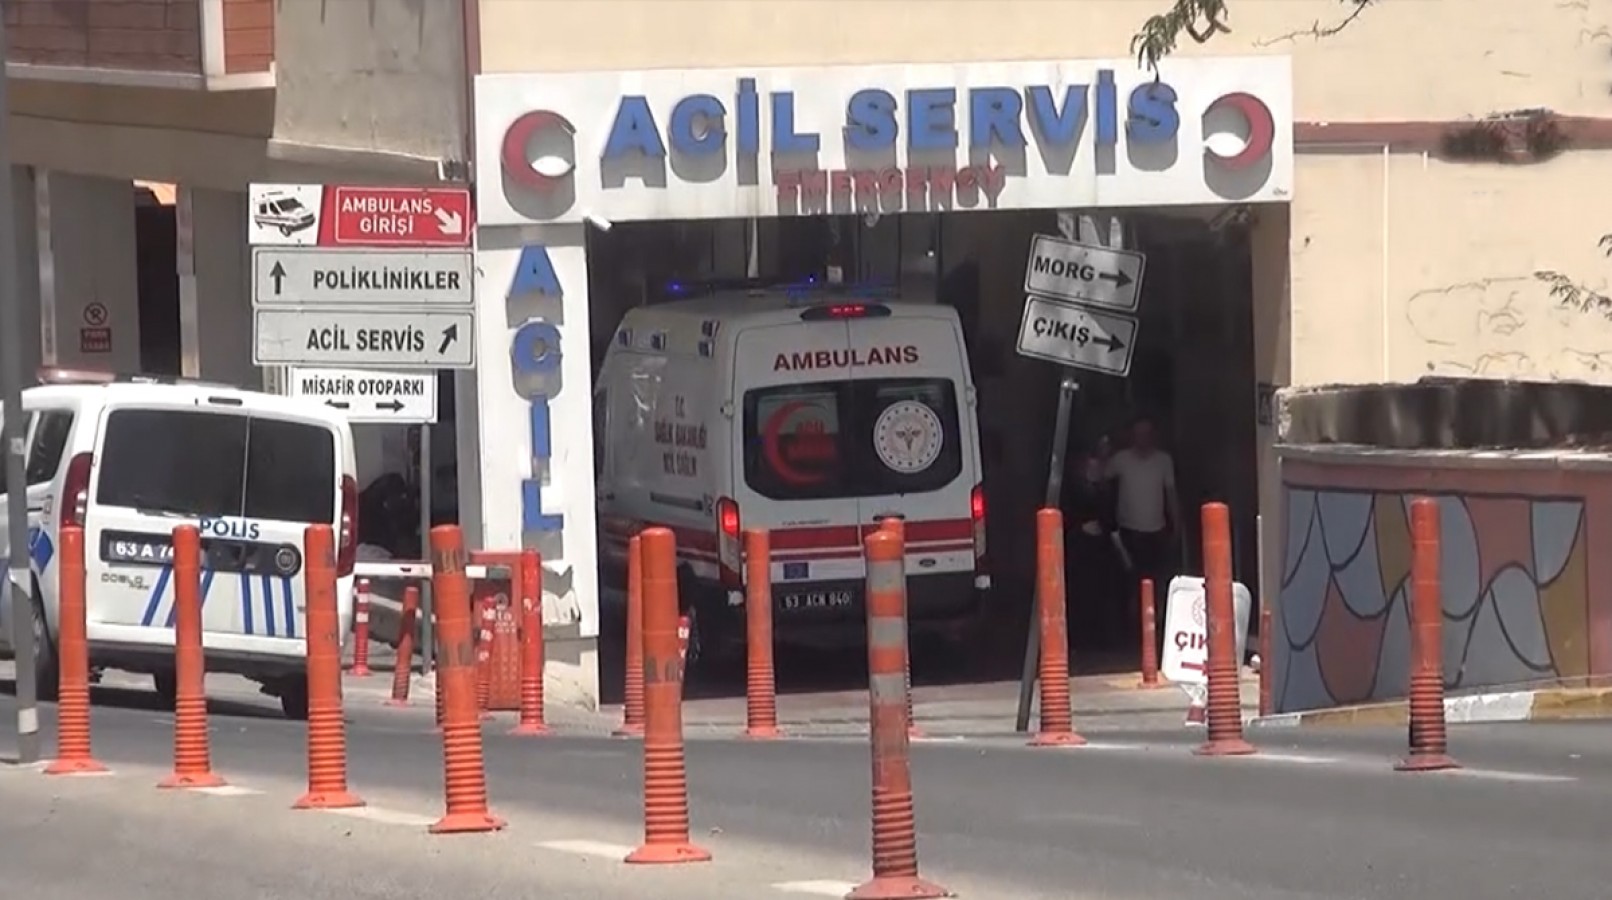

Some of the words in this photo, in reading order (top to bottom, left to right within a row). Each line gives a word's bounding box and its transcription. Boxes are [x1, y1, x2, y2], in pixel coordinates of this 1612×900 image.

[602, 78, 820, 158] ACİL
[846, 69, 1180, 152] SERVİS
[341, 197, 433, 213] AMBULANS
[359, 214, 414, 236] GİRİŞİ
[313, 266, 461, 291] POLİKLİNİKLER
[1033, 255, 1096, 282] MORG
[306, 324, 350, 351] ACİL
[356, 325, 425, 352] SERVİS
[1033, 316, 1091, 348] ÇIKIŞ
[773, 345, 920, 371] AMBULANS
[302, 375, 354, 396] MİSAFİR
[358, 378, 425, 396] OTOPARKI
[506, 244, 564, 532] ACİL
[115, 541, 137, 556] 63
[141, 544, 153, 557] A
[1174, 631, 1208, 652] ÇIK
